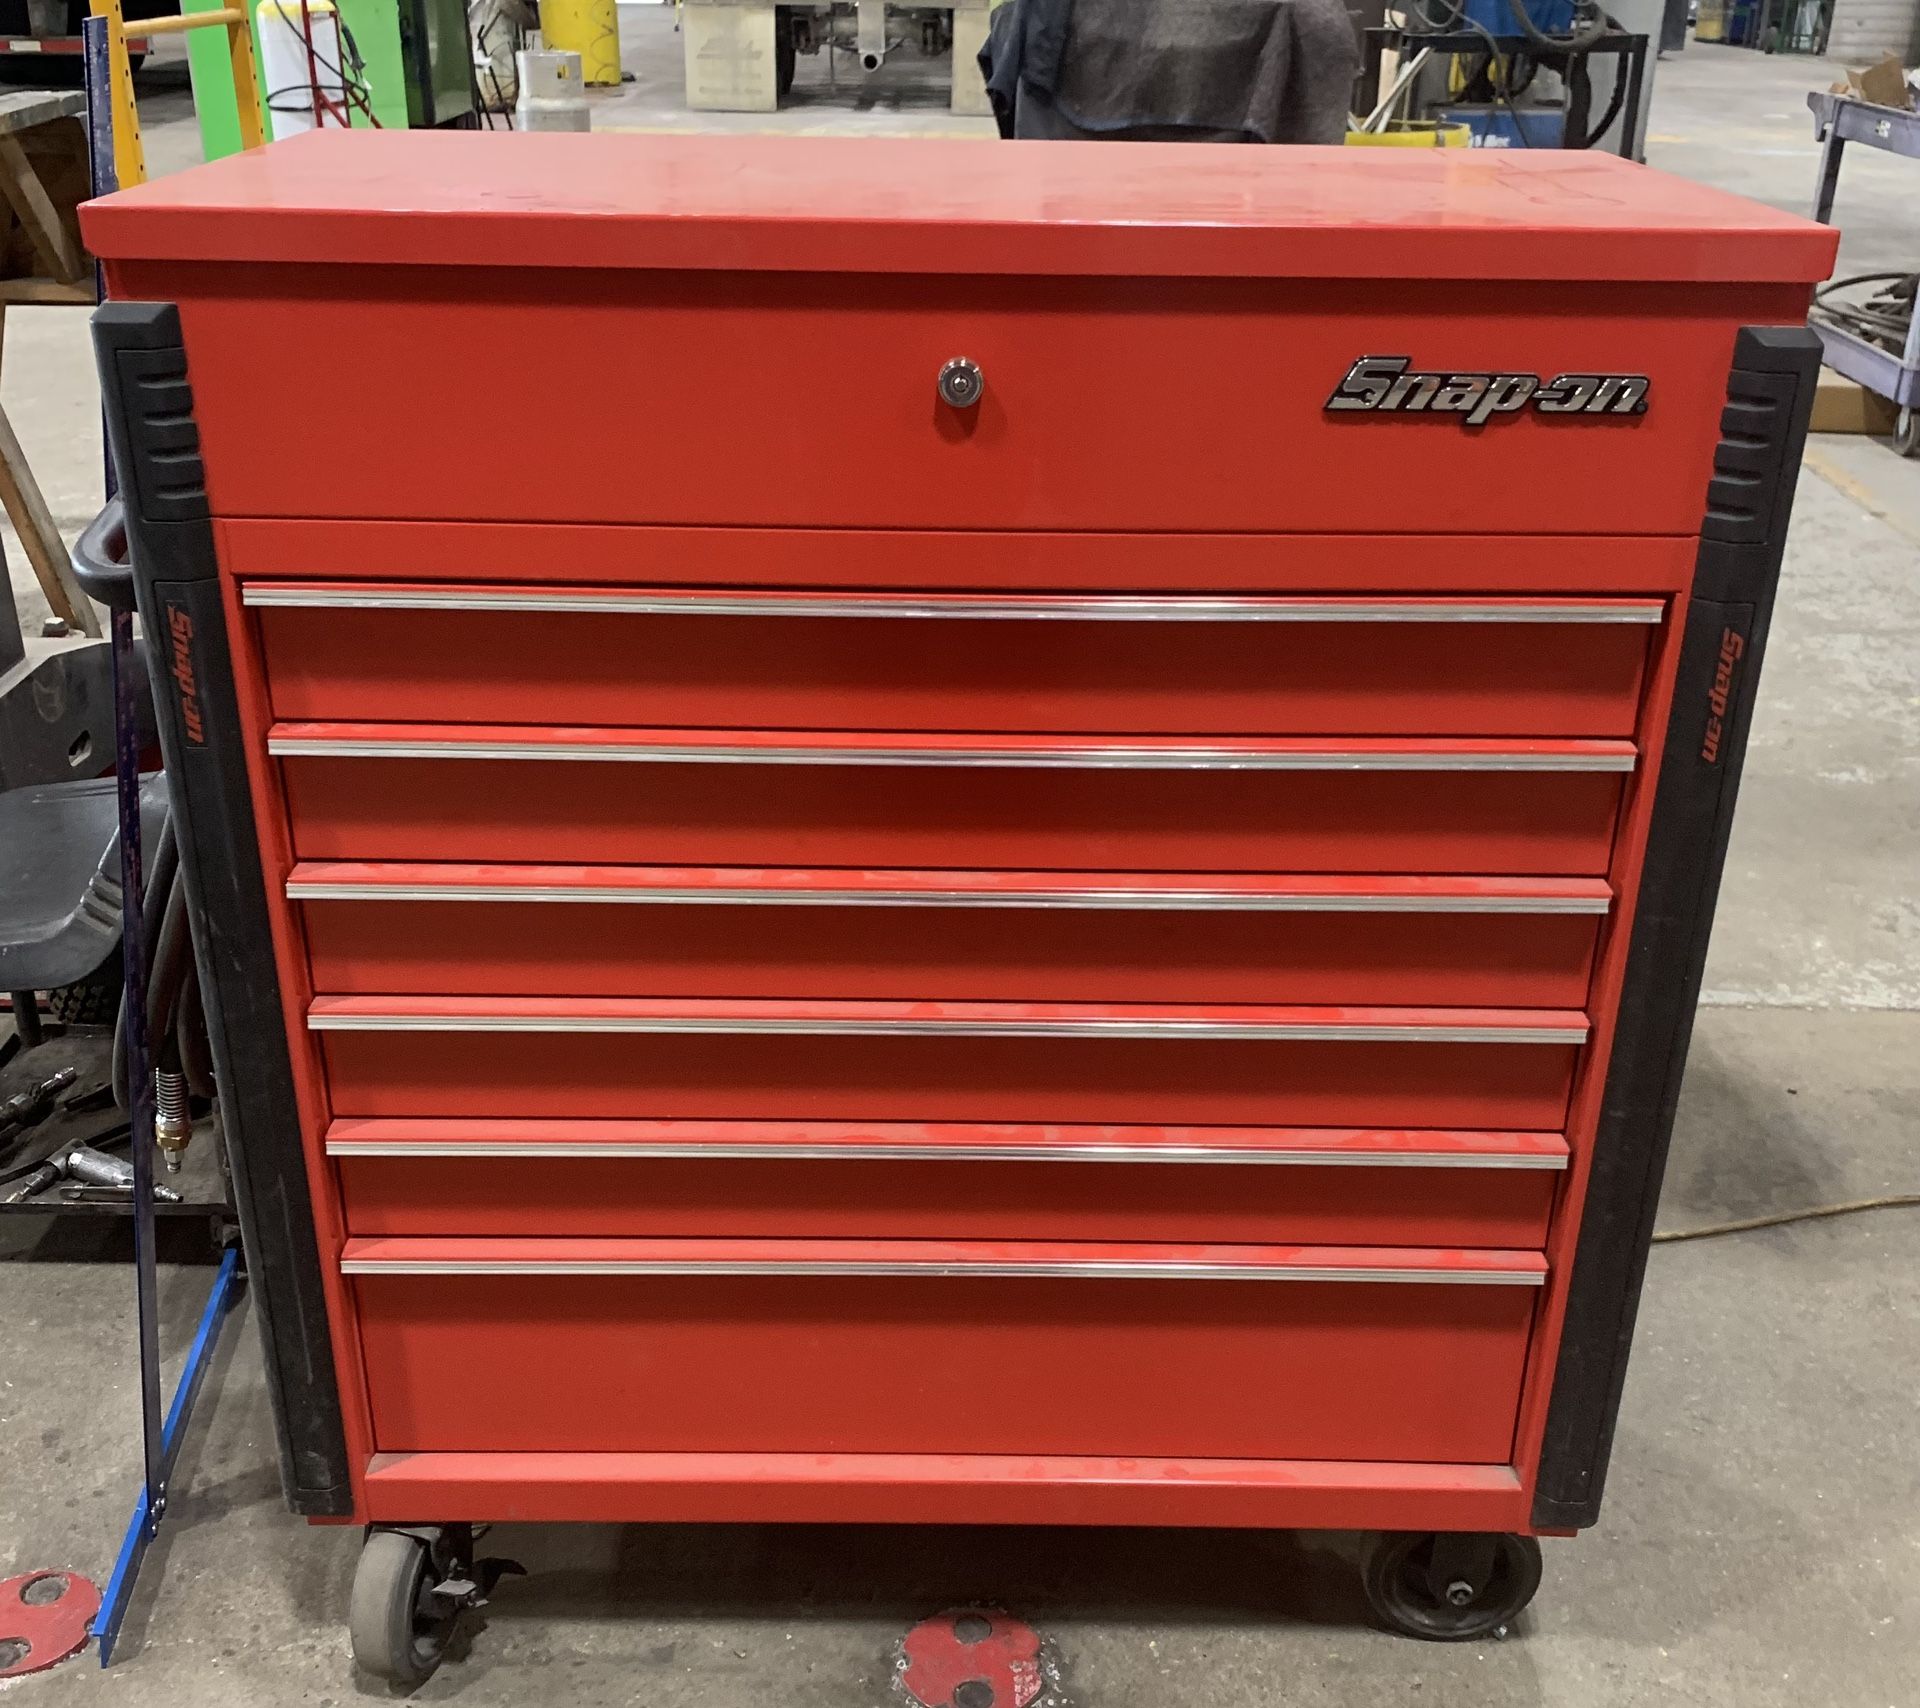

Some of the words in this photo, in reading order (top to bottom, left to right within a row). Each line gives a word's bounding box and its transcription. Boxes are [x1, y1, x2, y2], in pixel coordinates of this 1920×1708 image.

[1325, 355, 1649, 425] Snap-on
[167, 604, 204, 743] Snap-on
[1702, 627, 1744, 763] Snap-on
